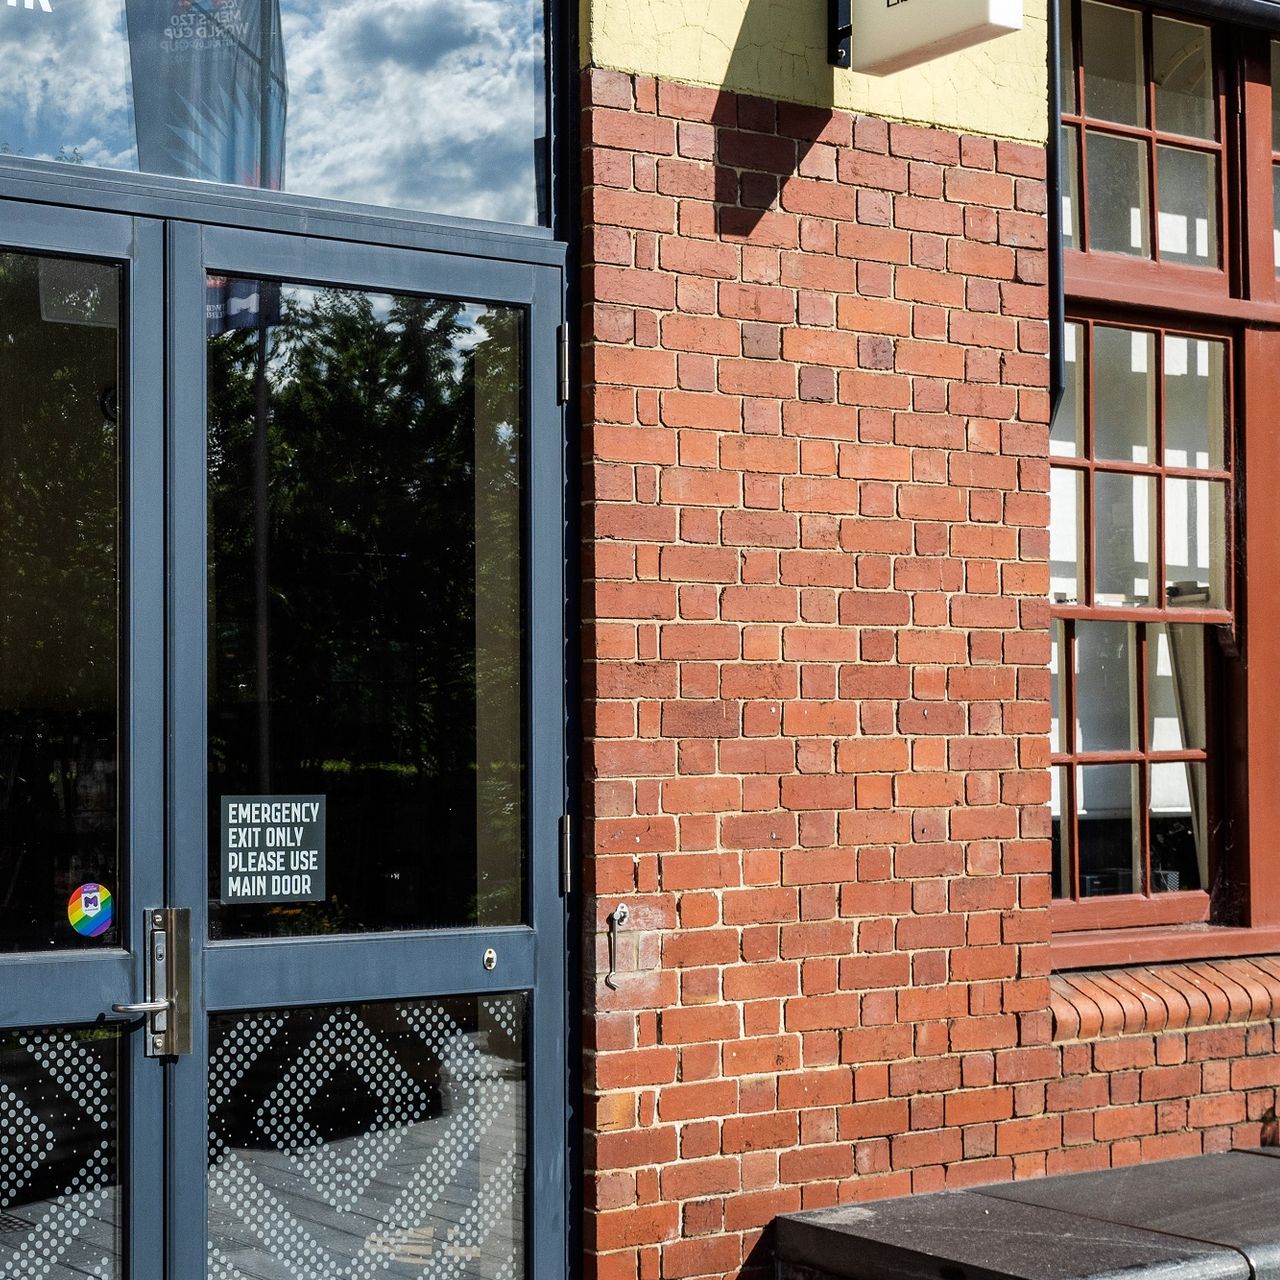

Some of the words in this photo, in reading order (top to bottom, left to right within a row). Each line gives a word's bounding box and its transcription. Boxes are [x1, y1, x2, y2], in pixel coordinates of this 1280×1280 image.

[228, 802, 319, 824] EMERGENCY
[228, 827, 261, 848] EXIT
[265, 826, 304, 847] ONLY
[228, 851, 286, 872] PLEASE
[290, 850, 319, 871] USE
[228, 875, 267, 897] MAIN
[271, 874, 312, 895] DOOR
